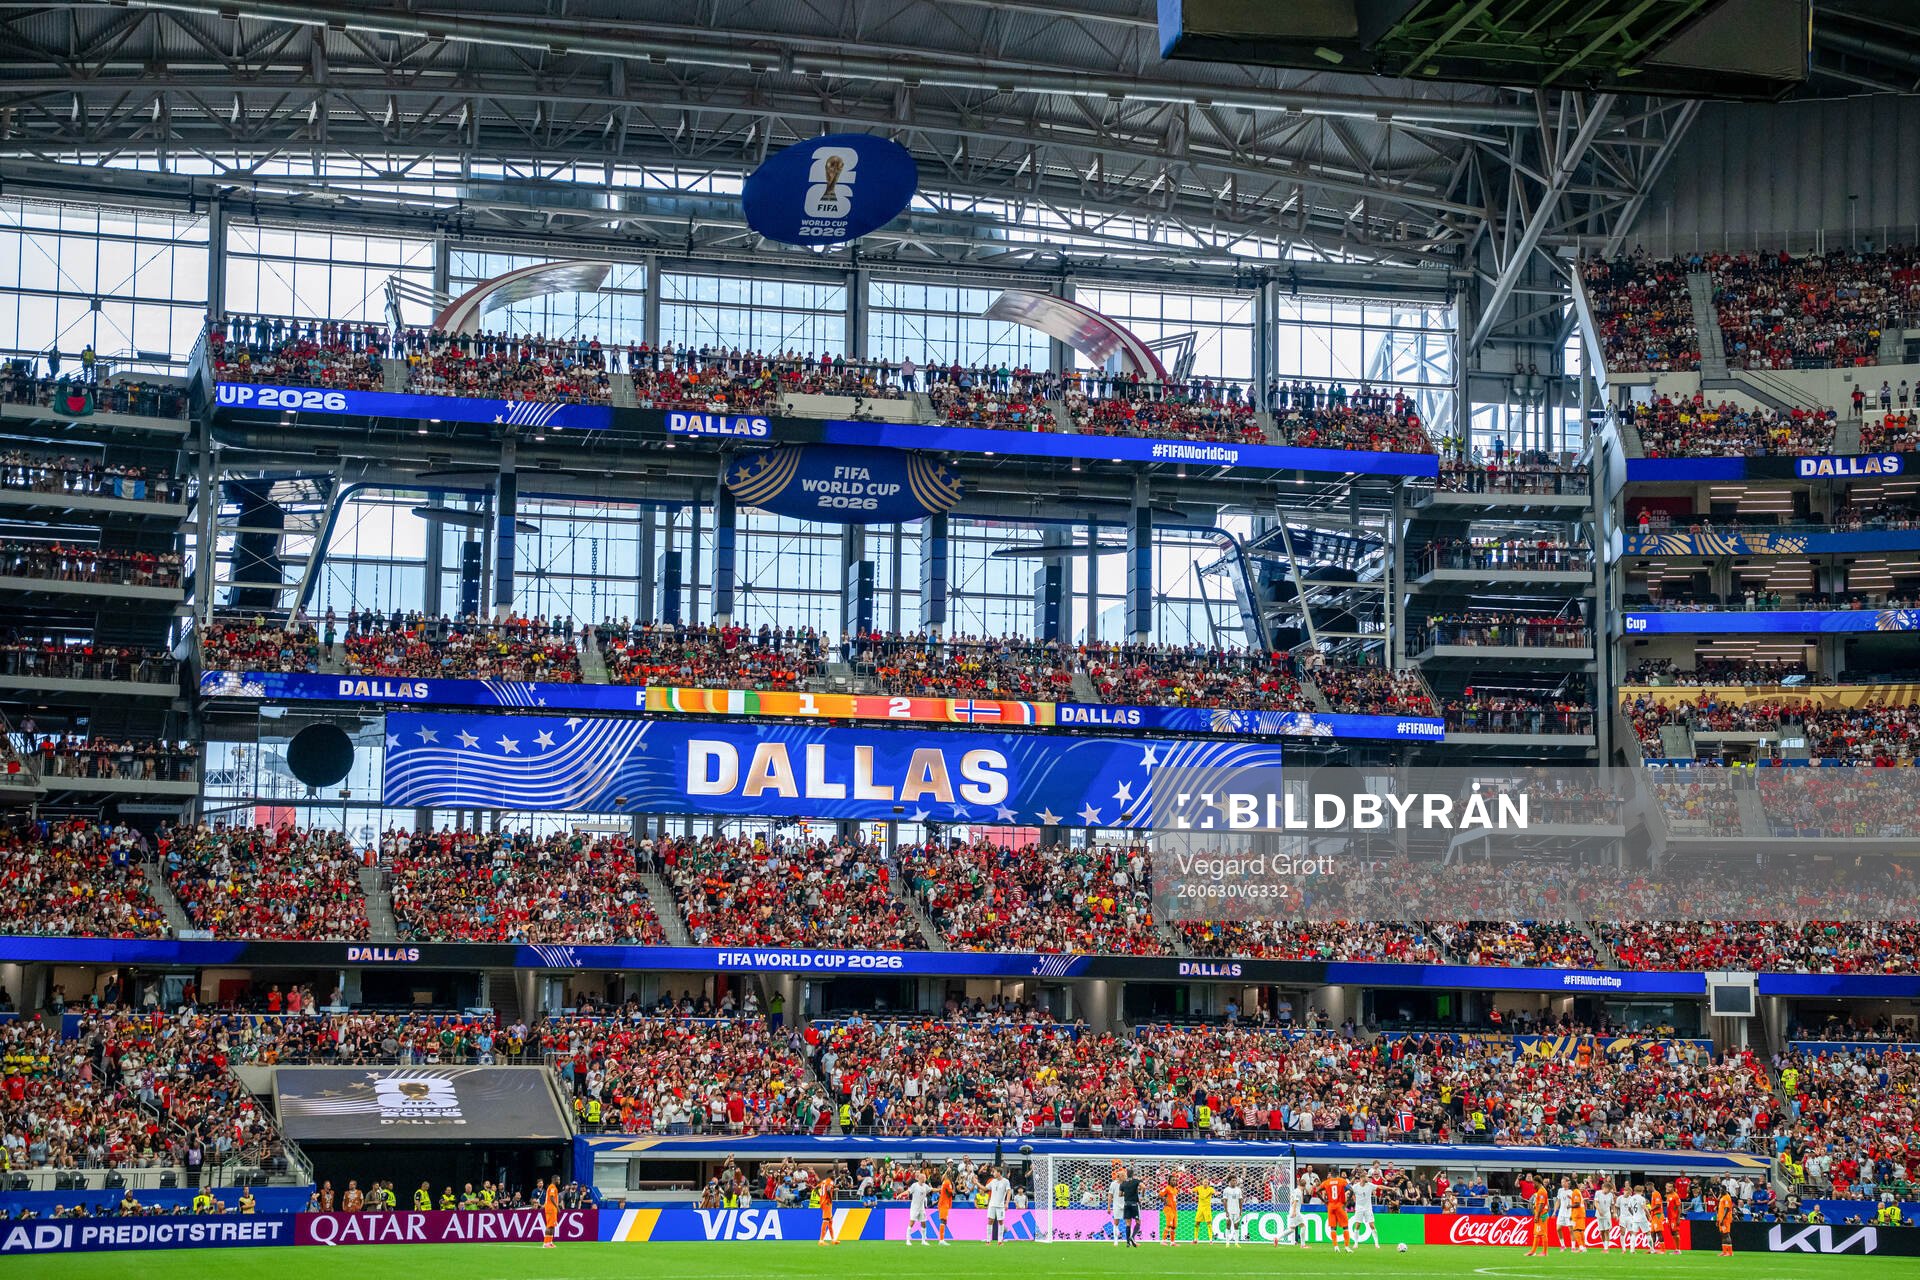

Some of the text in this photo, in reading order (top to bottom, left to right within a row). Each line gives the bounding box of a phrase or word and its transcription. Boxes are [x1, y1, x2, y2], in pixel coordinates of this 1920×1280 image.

[817, 204, 838, 212] FIFA
[798, 226, 847, 237] 2026
[801, 219, 848, 228] WORLD CUP
[215, 385, 346, 411] UP 2026
[670, 413, 767, 437] DALLAS
[1152, 443, 1239, 464] #FIFAWorldCup
[834, 465, 870, 480] FIFA
[1800, 456, 1899, 476] DALLAS
[801, 478, 901, 496] WORLD CUP
[817, 495, 879, 510] 2026
[1626, 616, 1647, 631] Cup
[338, 679, 429, 699] DALLAS
[799, 693, 911, 718] 1 2
[1061, 707, 1140, 725] DALLAS
[686, 739, 1009, 807] DALLAS
[347, 947, 420, 961] DALLAS
[717, 952, 903, 969] FIFA WORLD CUP 2026
[1179, 962, 1242, 976] DALLAS
[1563, 975, 1622, 988] #FIFAWorldCup
[310, 1212, 584, 1246] QATAR AIRWAYS
[692, 1209, 783, 1240] VISA
[1, 1221, 283, 1250] ADI PREDICTSTREET
